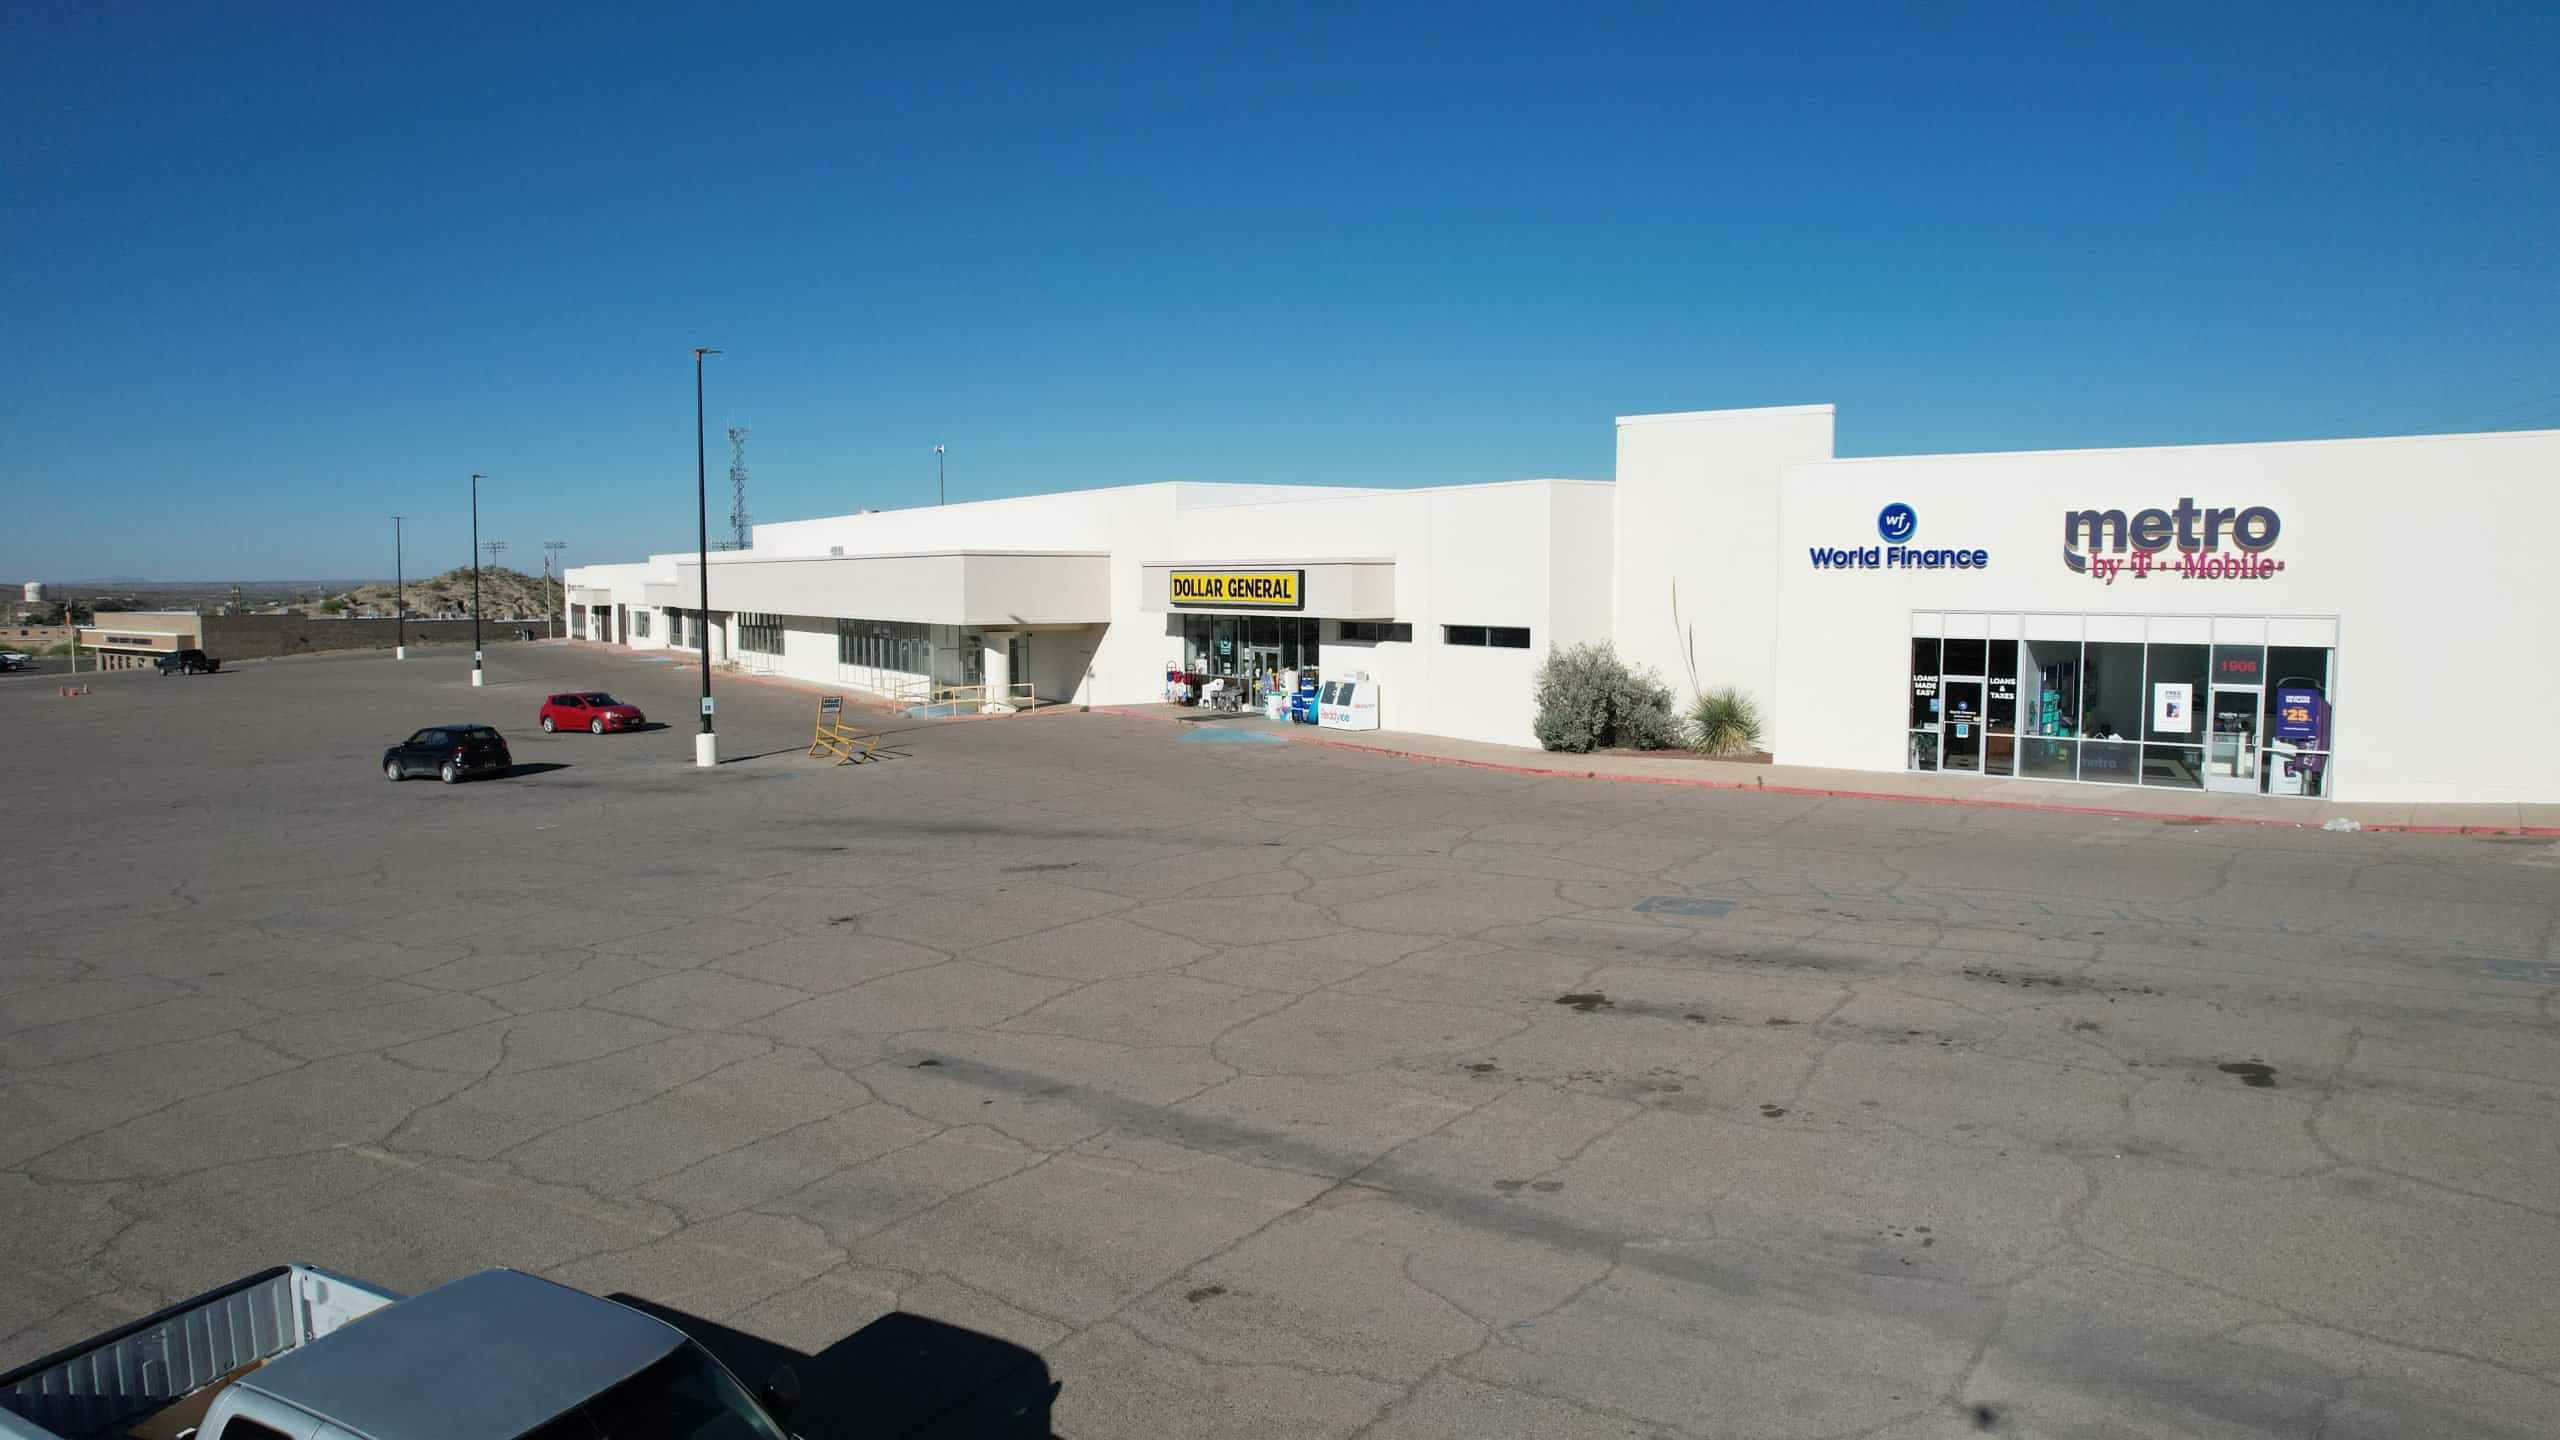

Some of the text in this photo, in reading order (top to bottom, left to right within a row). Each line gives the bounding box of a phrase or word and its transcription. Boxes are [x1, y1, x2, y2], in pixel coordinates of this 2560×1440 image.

[1885, 512, 1907, 529] wf
[2065, 497, 2281, 553] metro
[1809, 545, 1989, 568] World Finance
[2092, 551, 2124, 585] by
[1173, 578, 1292, 599] DOLLAR GENERAL
[1990, 677, 2016, 685] LOANS
[1990, 692, 2015, 700] TAXES
